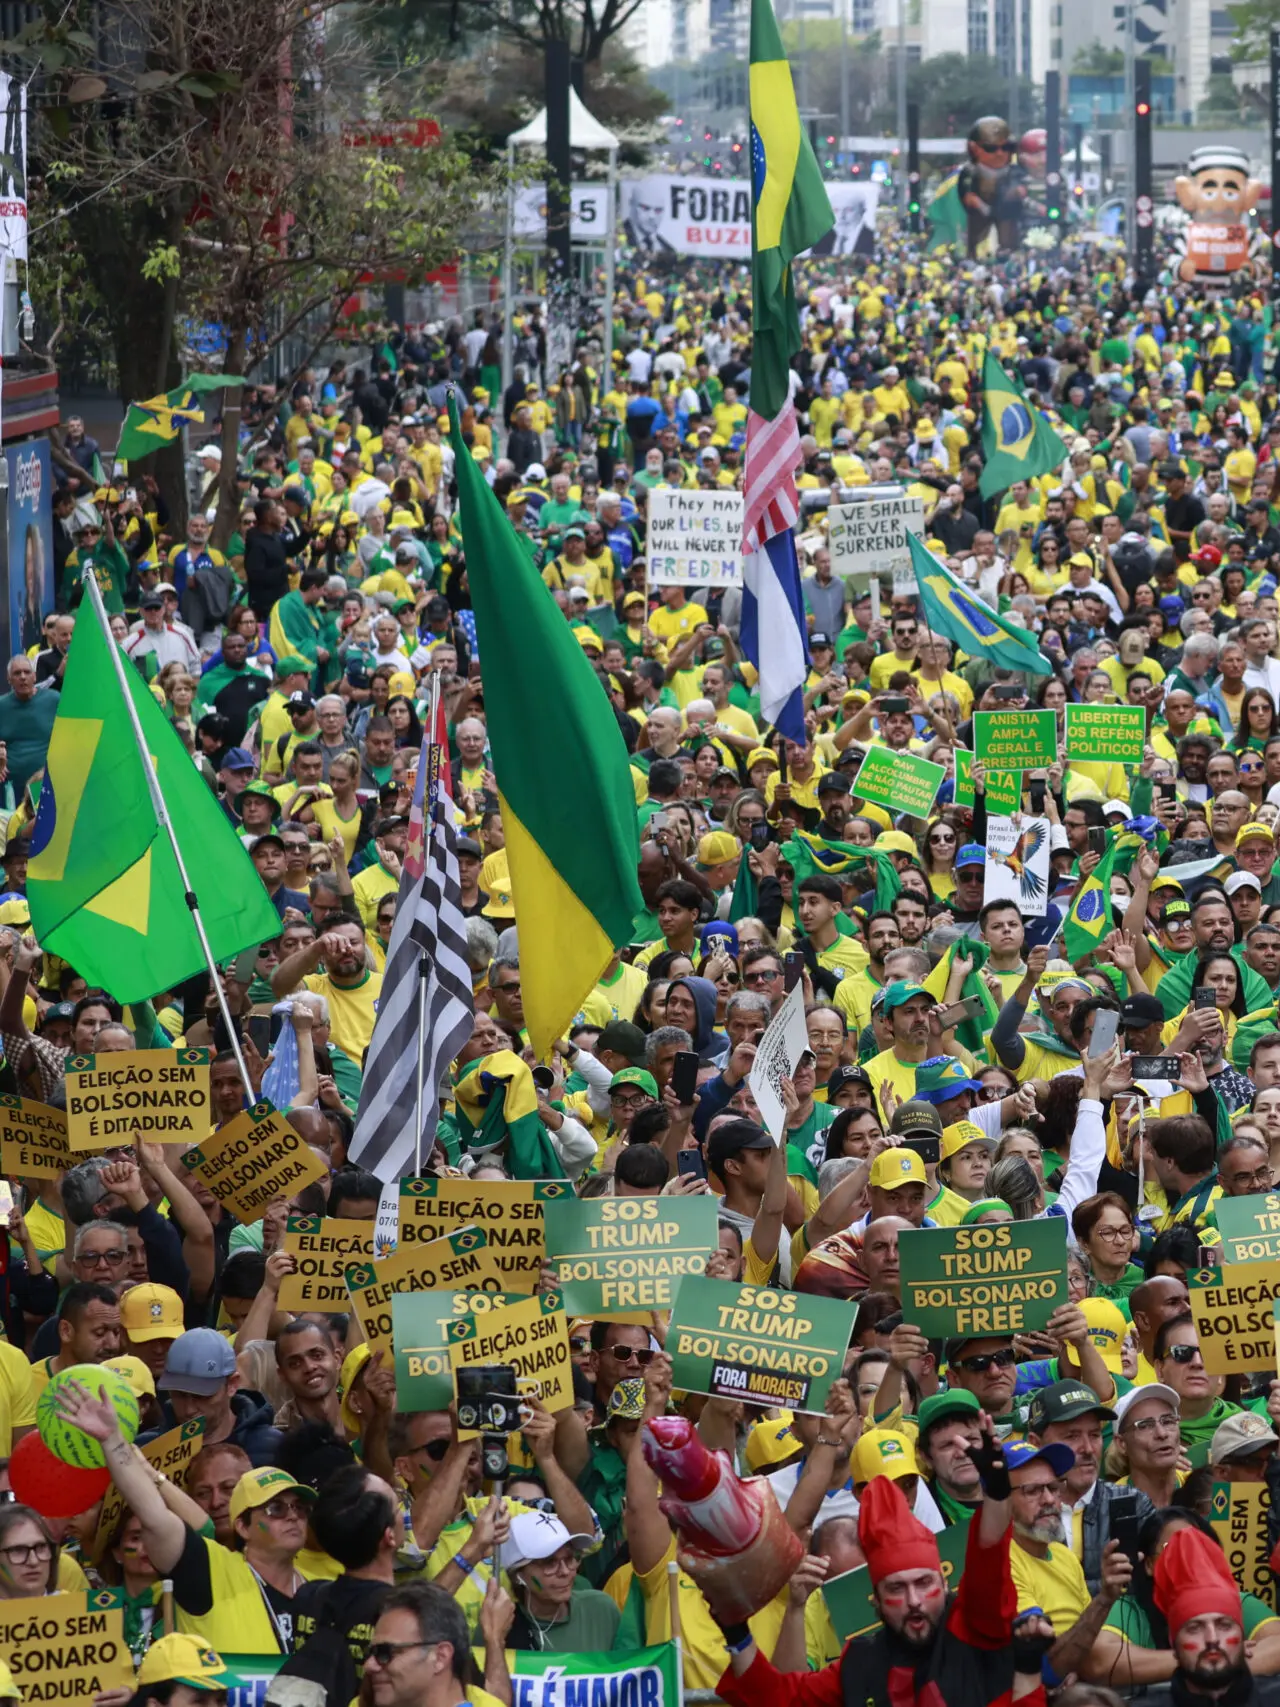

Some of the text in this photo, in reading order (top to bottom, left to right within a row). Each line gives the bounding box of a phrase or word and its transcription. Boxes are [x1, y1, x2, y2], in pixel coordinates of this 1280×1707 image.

[578, 199, 597, 222] 5
[668, 184, 750, 222] FORA
[668, 494, 741, 512] They MAY
[840, 502, 922, 522] WE SHALL
[651, 517, 676, 532] OUR
[846, 518, 901, 538] NEVER
[651, 536, 733, 552] WILL NEVER
[988, 713, 1040, 725] ANISTIA
[1071, 711, 1139, 725] LIBERTEM
[992, 728, 1037, 739] AMPLA
[1067, 726, 1143, 741] OS REFÉNS
[987, 741, 1043, 754] GERAL E
[1069, 739, 1140, 756] POLÍTICOS
[860, 770, 873, 782] SE
[874, 773, 894, 787] NÃO
[868, 762, 933, 790] ALCOLUMBRE
[857, 780, 929, 810] VAMOS CASSAR
[78, 1065, 196, 1090] ELEIÇÃO SEM
[71, 1090, 206, 1116] BOLSONARO
[9, 1109, 67, 1136] ELEIÇÃO
[90, 1115, 194, 1137] É DITADURA
[20, 1147, 28, 1165] É
[200, 1119, 279, 1180] ELEIÇÃO SEM
[210, 1134, 300, 1202] BOLSONARO
[236, 1160, 309, 1213] É DITADURA
[414, 1197, 504, 1224] ELEIÇÃO
[601, 1200, 659, 1222] SOS
[298, 1235, 374, 1258] ELEIÇÃO
[586, 1222, 680, 1249] TRUMP
[955, 1226, 1012, 1250] SOS
[558, 1255, 707, 1283] BOLSONARO
[940, 1248, 1032, 1276] TRUMP
[363, 1254, 481, 1308] ELEIÇÃO SEM
[601, 1278, 672, 1308] FREE
[914, 1279, 1057, 1308] BOLSONARO
[452, 1293, 506, 1315] SOS
[736, 1287, 798, 1314] SOS
[718, 1306, 813, 1341] TRUMP
[956, 1304, 1024, 1333] FREE
[462, 1316, 558, 1362] ELEIÇÃO SEM
[1225, 1340, 1236, 1361] É
[677, 1334, 829, 1377] BOLSONARO
[713, 1366, 747, 1389] FORA
[749, 1372, 808, 1401] MORAES!
[163, 1441, 192, 1468] SEM
[1230, 1499, 1250, 1545] SEM
[64, 1613, 107, 1637] SEM
[564, 1669, 660, 1707] MAIOR
